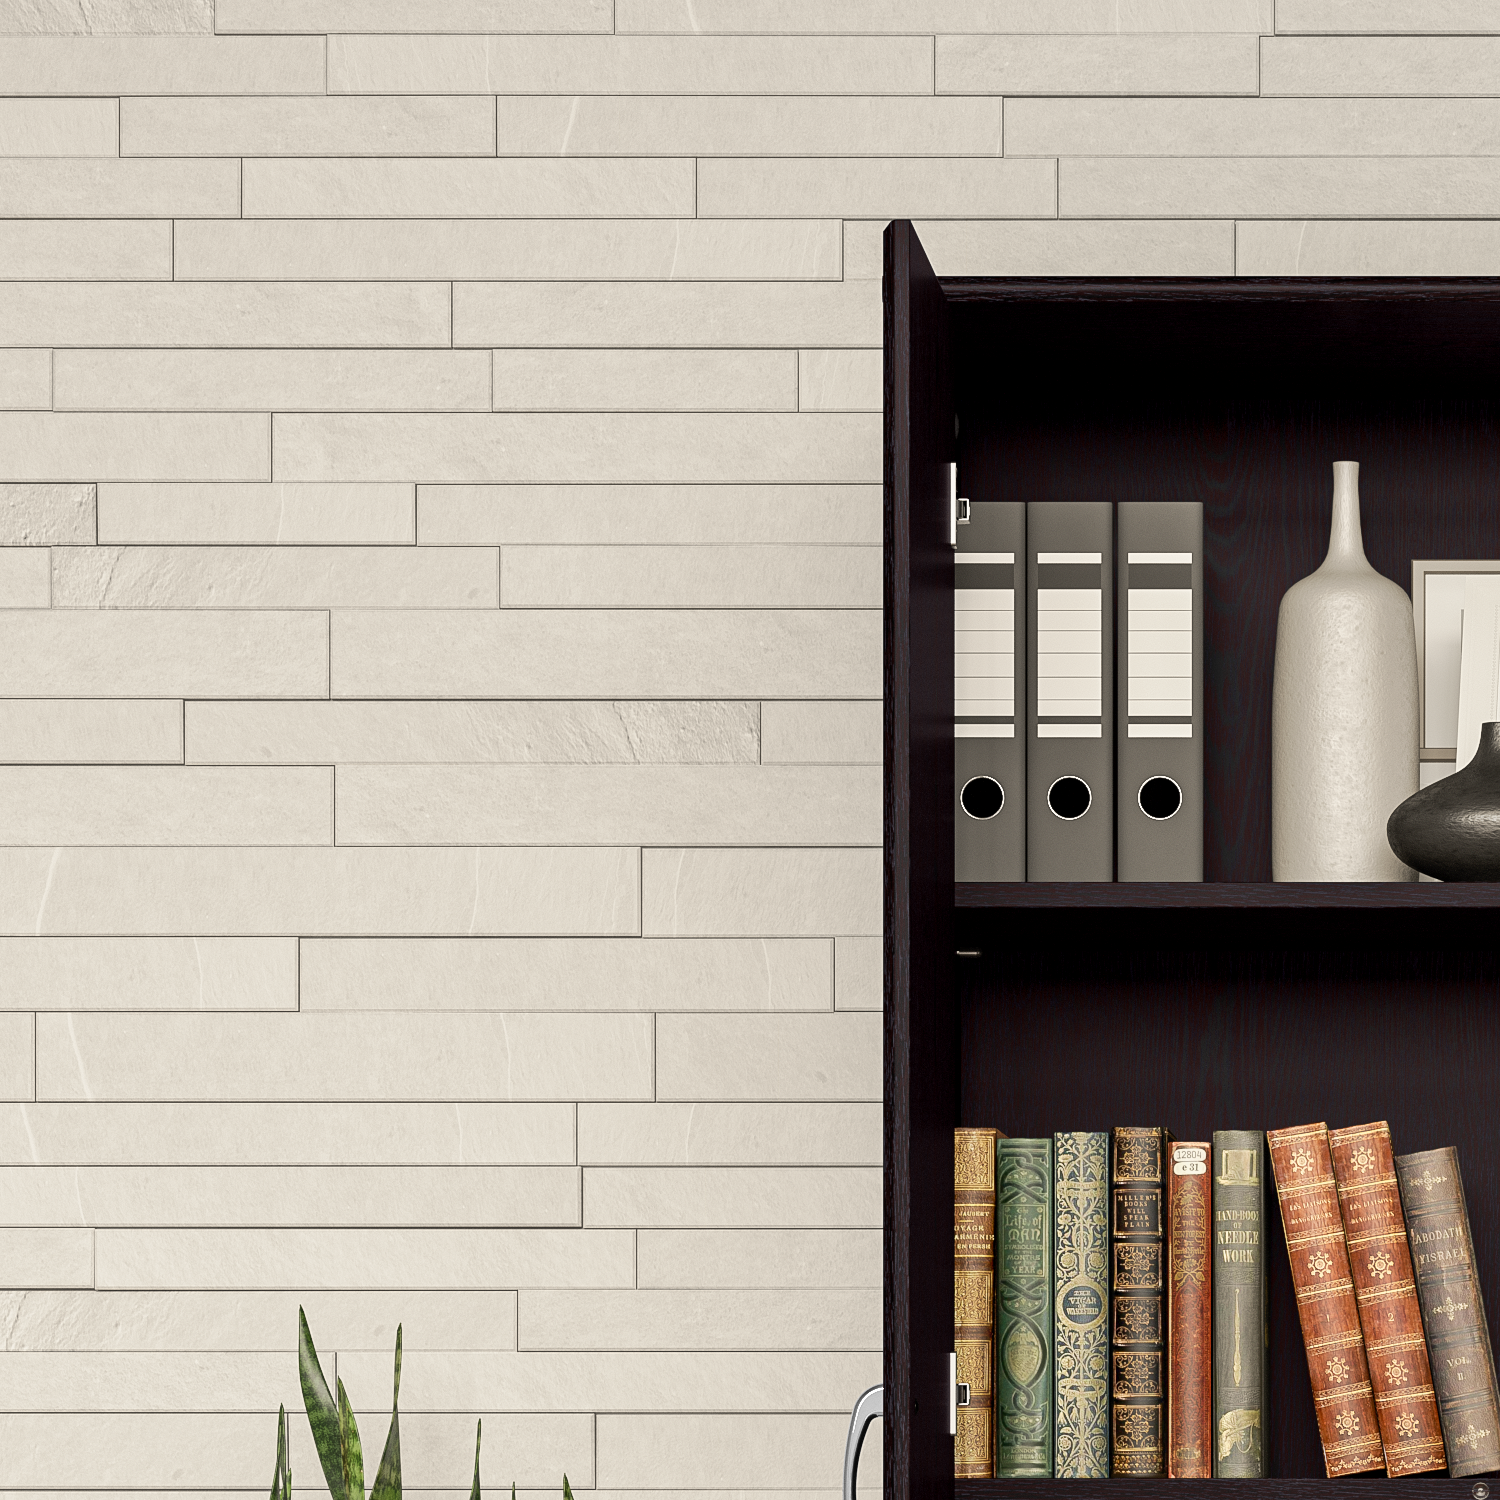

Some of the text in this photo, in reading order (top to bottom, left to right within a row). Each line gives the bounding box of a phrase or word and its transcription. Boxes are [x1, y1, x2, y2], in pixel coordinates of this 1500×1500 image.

[1177, 1150, 1202, 1159] 12804
[1189, 1163, 1199, 1171] 31
[1117, 1194, 1157, 1202] MILLER'S
[1124, 1200, 1149, 1208] BOOKS
[1031, 1214, 1043, 1229] of
[1217, 1230, 1259, 1245] NEEDLE
[1415, 1226, 1464, 1245] ABODATH
[1222, 1249, 1255, 1263] WORK
[1419, 1247, 1467, 1264] YISRAEL
[1011, 1266, 1036, 1274] YEAR
[1067, 1296, 1098, 1305] VICAR
[1387, 1312, 1395, 1322] 2
